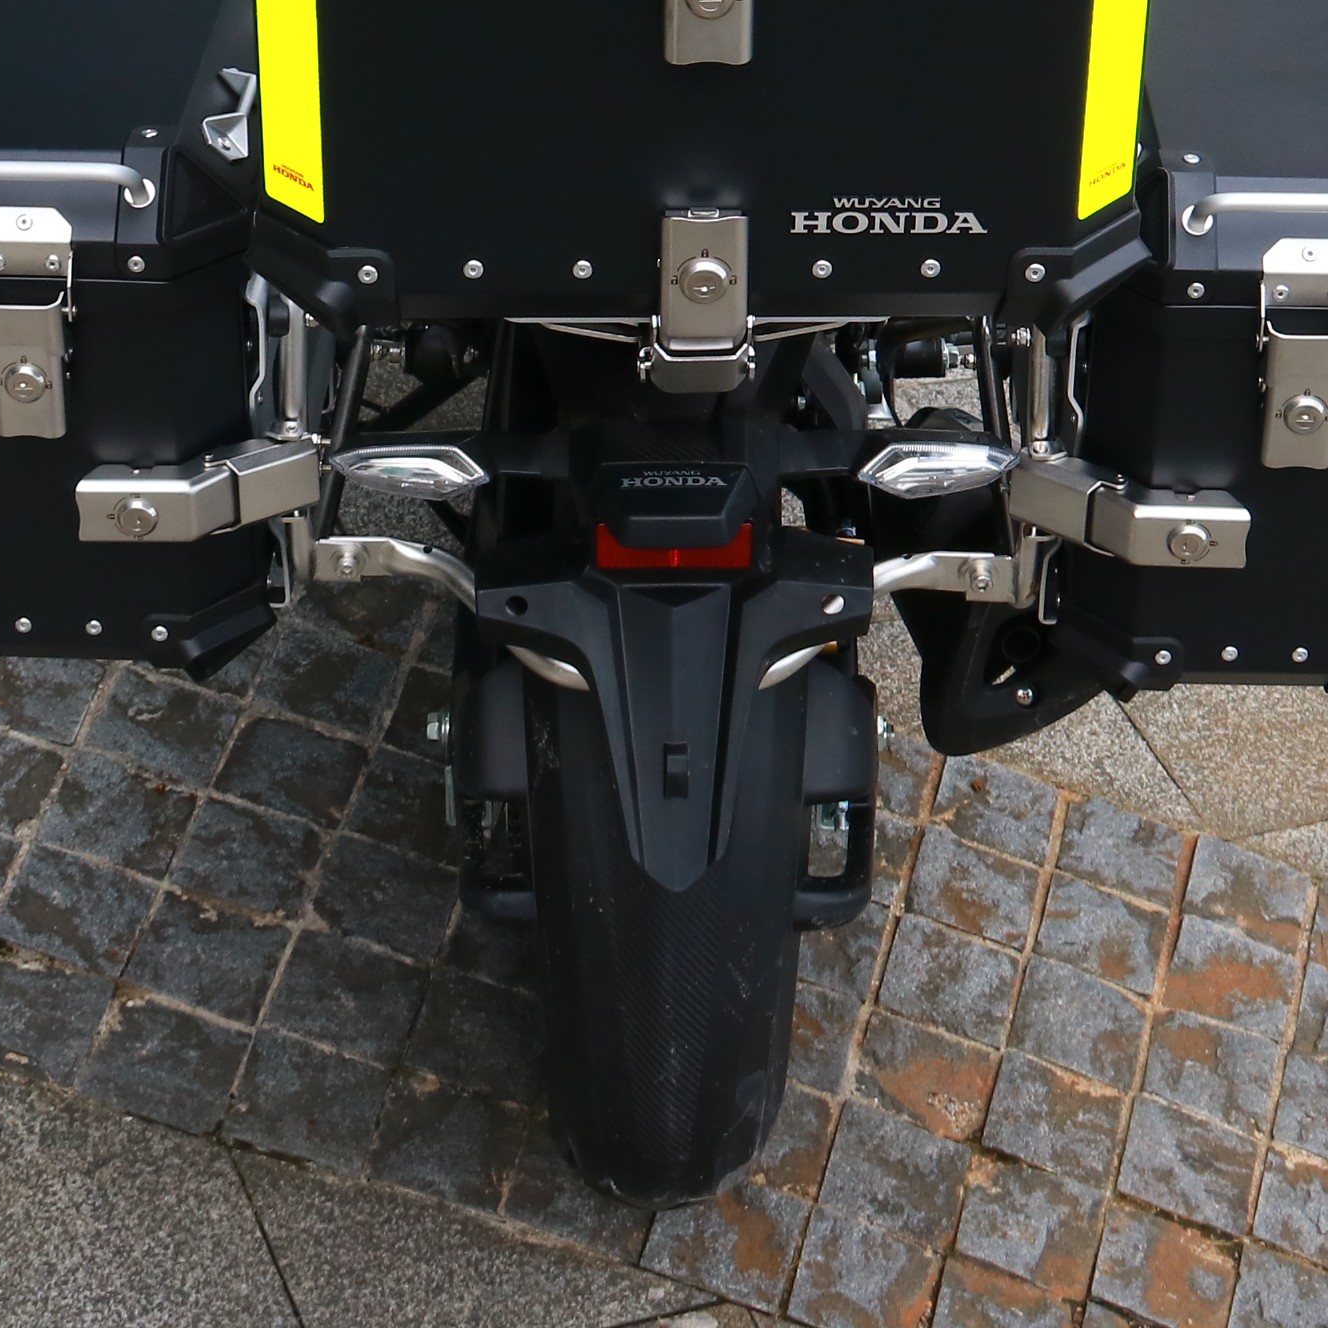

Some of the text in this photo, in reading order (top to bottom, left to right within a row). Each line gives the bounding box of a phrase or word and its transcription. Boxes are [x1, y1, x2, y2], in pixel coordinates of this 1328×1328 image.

[272, 163, 315, 192] HONDA
[832, 197, 942, 209] WUYANG
[790, 211, 988, 234] HONDA
[621, 476, 728, 488] HONDA
